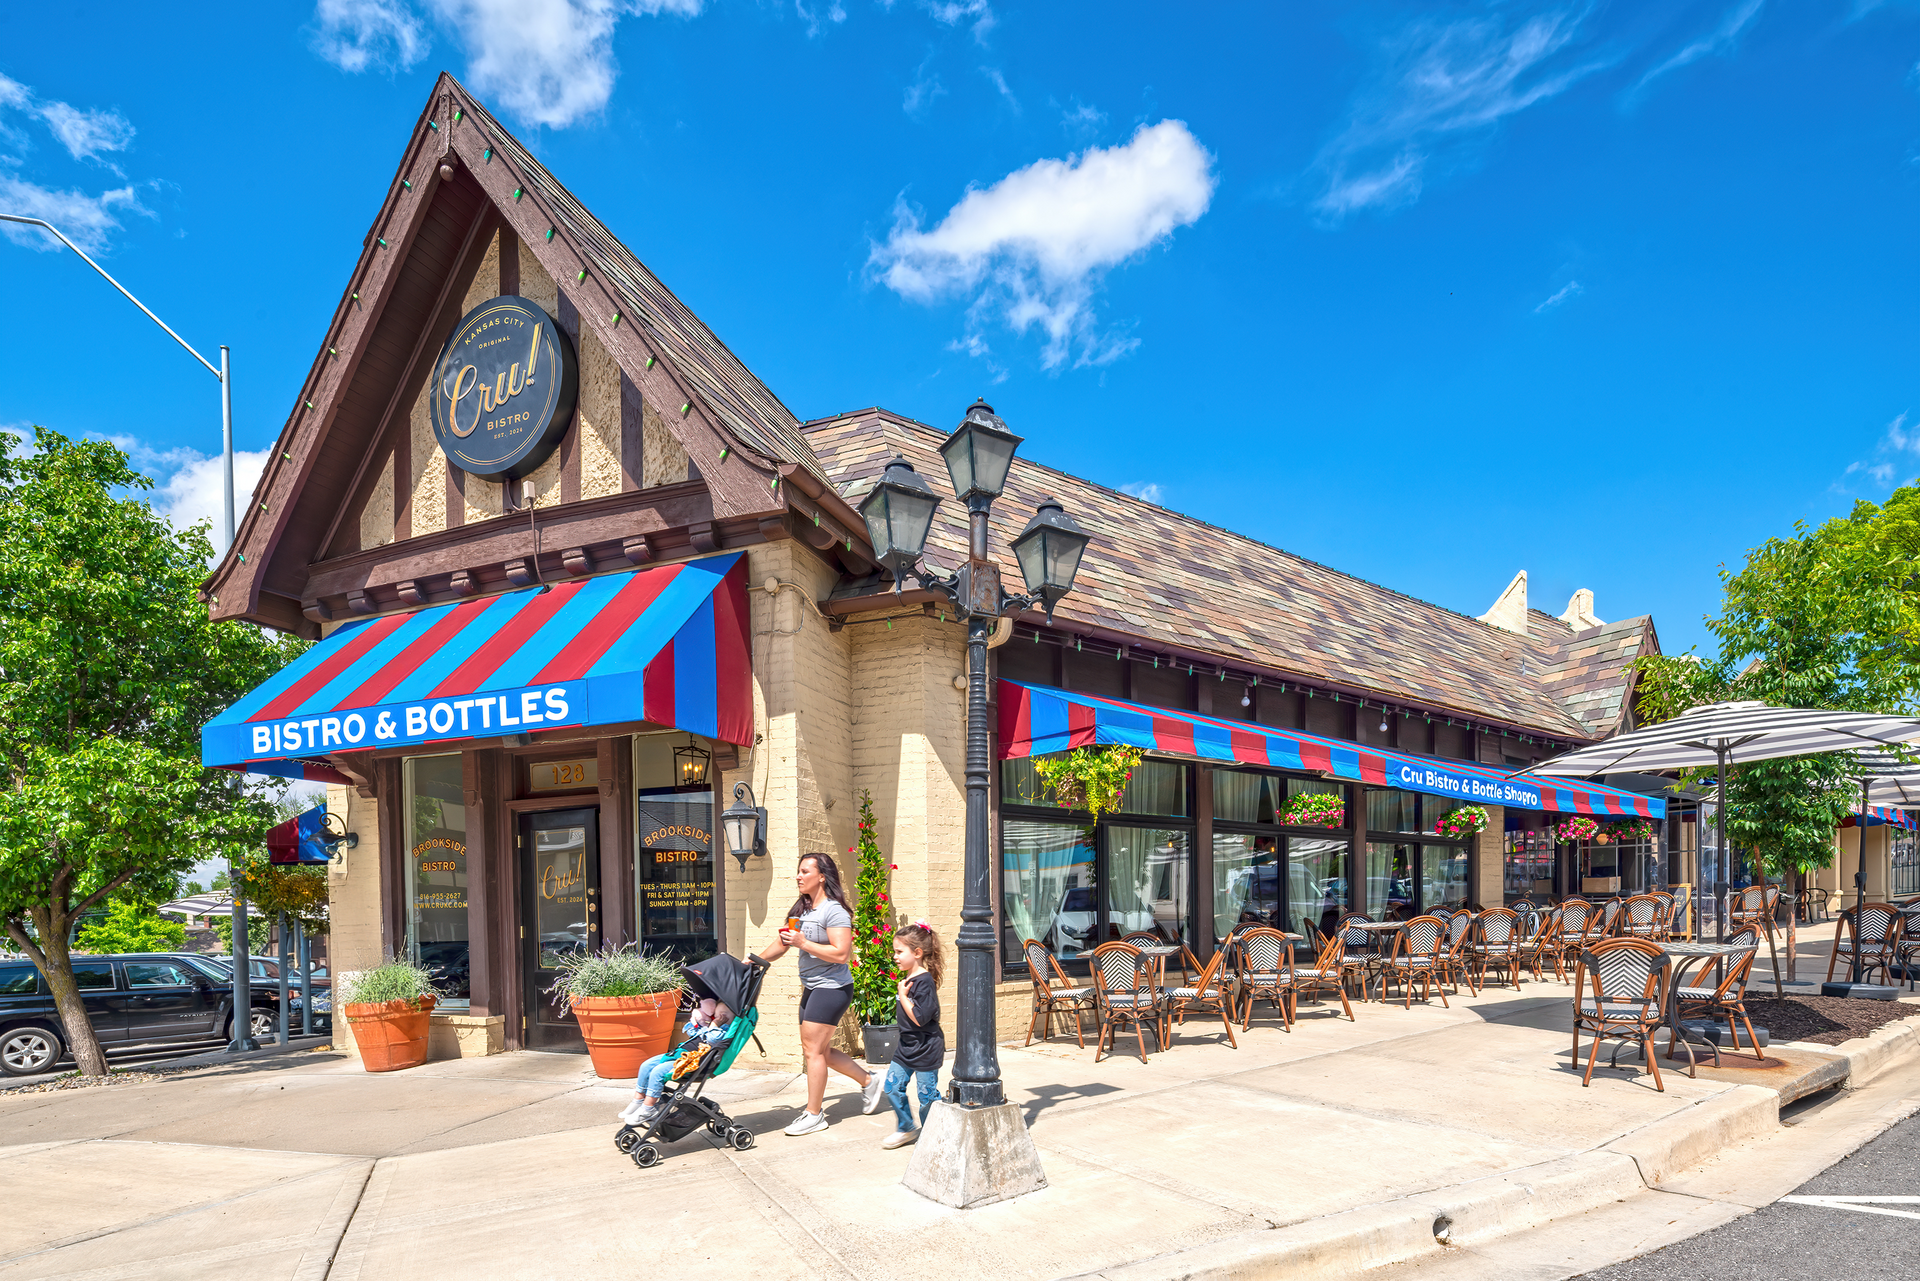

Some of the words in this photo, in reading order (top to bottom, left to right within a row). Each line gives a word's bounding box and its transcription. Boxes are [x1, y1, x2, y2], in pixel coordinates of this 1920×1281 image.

[464, 317, 501, 346] KANSAS
[504, 316, 525, 328] CITY
[478, 336, 511, 349] ORIGINAL
[443, 321, 544, 439] Cru!
[487, 411, 530, 431] BISTRO
[494, 431, 507, 440] EST.
[509, 427, 523, 436] 2024
[252, 713, 366, 754] BISTRO
[374, 711, 397, 739] &
[405, 688, 569, 737] BOTTLES
[551, 763, 585, 785] 128
[1401, 766, 1423, 784] Cru
[1425, 770, 1459, 791] Bistro
[1461, 779, 1470, 793] &
[1472, 780, 1503, 799] Bottle
[643, 825, 712, 847] BROOKSIDE
[412, 838, 467, 858] BROOKSIDE
[655, 850, 698, 863] BISTRO
[422, 860, 456, 872] BISTRO
[539, 853, 583, 900] Cru!
[413, 901, 468, 909] WWW.CRUKC.COM
[419, 892, 461, 900] 816-955-2627
